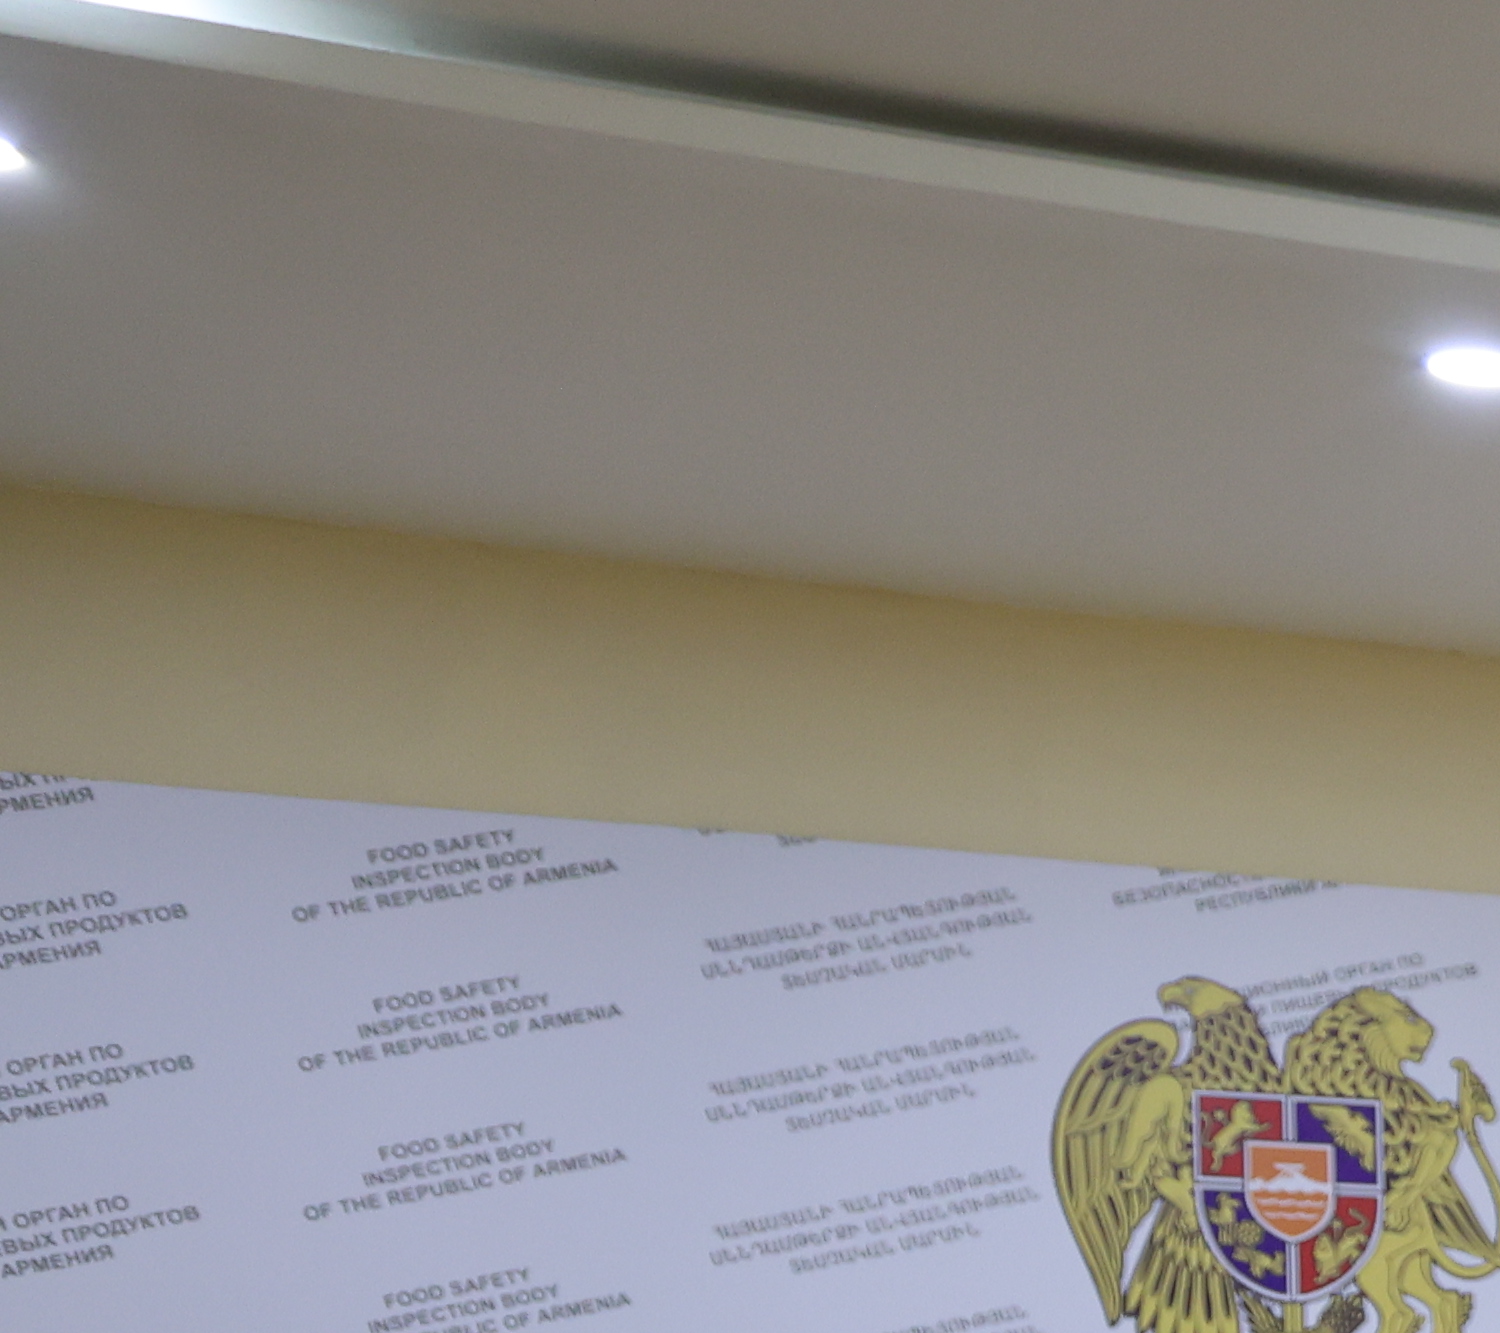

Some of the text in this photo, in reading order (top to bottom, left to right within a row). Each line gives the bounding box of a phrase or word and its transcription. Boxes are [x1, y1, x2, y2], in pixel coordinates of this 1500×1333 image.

[366, 830, 513, 864] FOOD SAFETY
[351, 848, 544, 889] INSPECTION BODY
[0, 891, 118, 922] ОРГАН ПО
[291, 859, 619, 923] OF THE REPUBLIC OF ARMENIA
[49, 904, 189, 935] ПРОДУКТОВ
[372, 976, 520, 1013] FOOD SAFETY
[357, 993, 549, 1038] INSPECTION BODY
[297, 1004, 624, 1073] OF THE REPUBLIC OF ARMENIA
[5, 1043, 124, 1076] ОРГАН ПО
[55, 1055, 195, 1088] ПРОДУКТОВ
[0, 1093, 110, 1123] АРМЕНИЯ
[377, 1122, 525, 1161] FOOD SAFETY
[362, 1139, 555, 1186] INSPECTION BODY
[302, 1149, 628, 1222] OF THE REPUBLIC OF ARMENIA
[12, 1195, 130, 1229] ОРГАН ПО
[62, 1206, 201, 1241] ПРОДУКТОВ
[1, 1245, 115, 1277] АРМЕНИЯ
[382, 1268, 530, 1308] FOOD SAFETY
[367, 1284, 558, 1333] INSPECTION BODY
[503, 1312, 530, 1331] OF
[538, 1293, 633, 1322] ARMENIA
